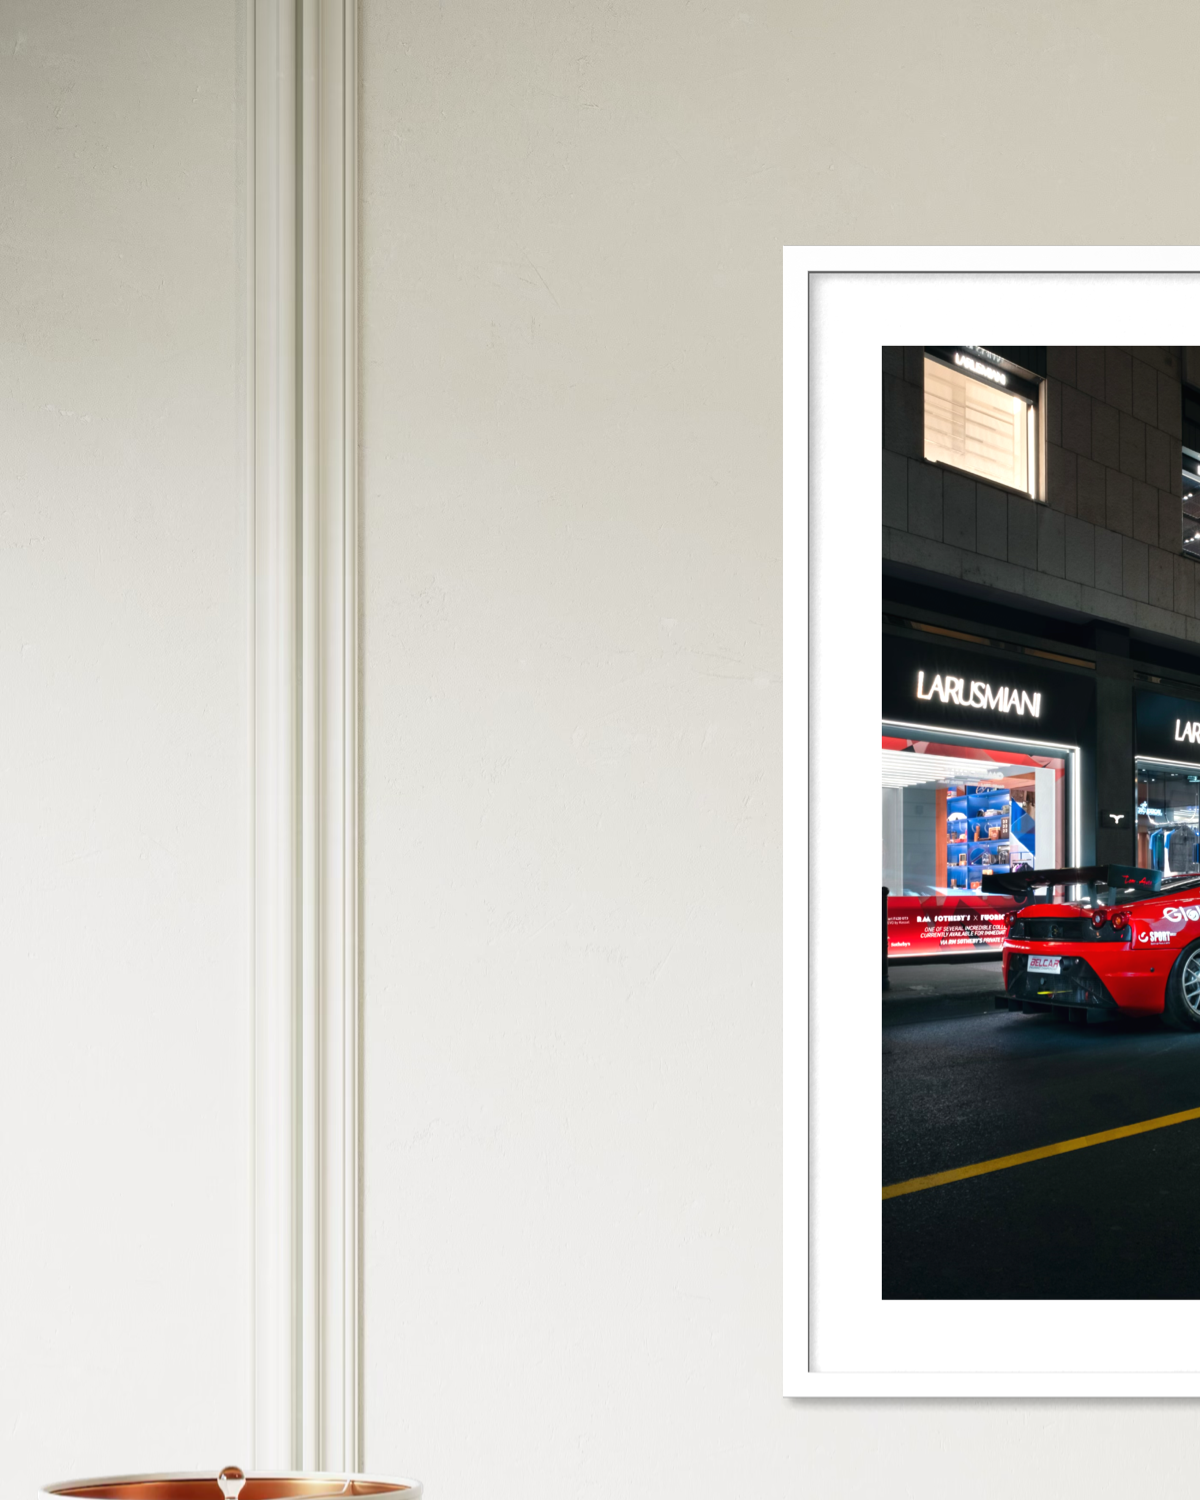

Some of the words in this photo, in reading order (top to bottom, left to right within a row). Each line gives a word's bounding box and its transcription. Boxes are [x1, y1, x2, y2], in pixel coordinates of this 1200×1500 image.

[917, 671, 1041, 718] LARUSMIANI
[934, 914, 971, 922] SOTHEBY'S
[920, 931, 949, 939] CURRENTLY
[1150, 931, 1170, 942] SPORT
[1030, 958, 1060, 968] BELCAR
